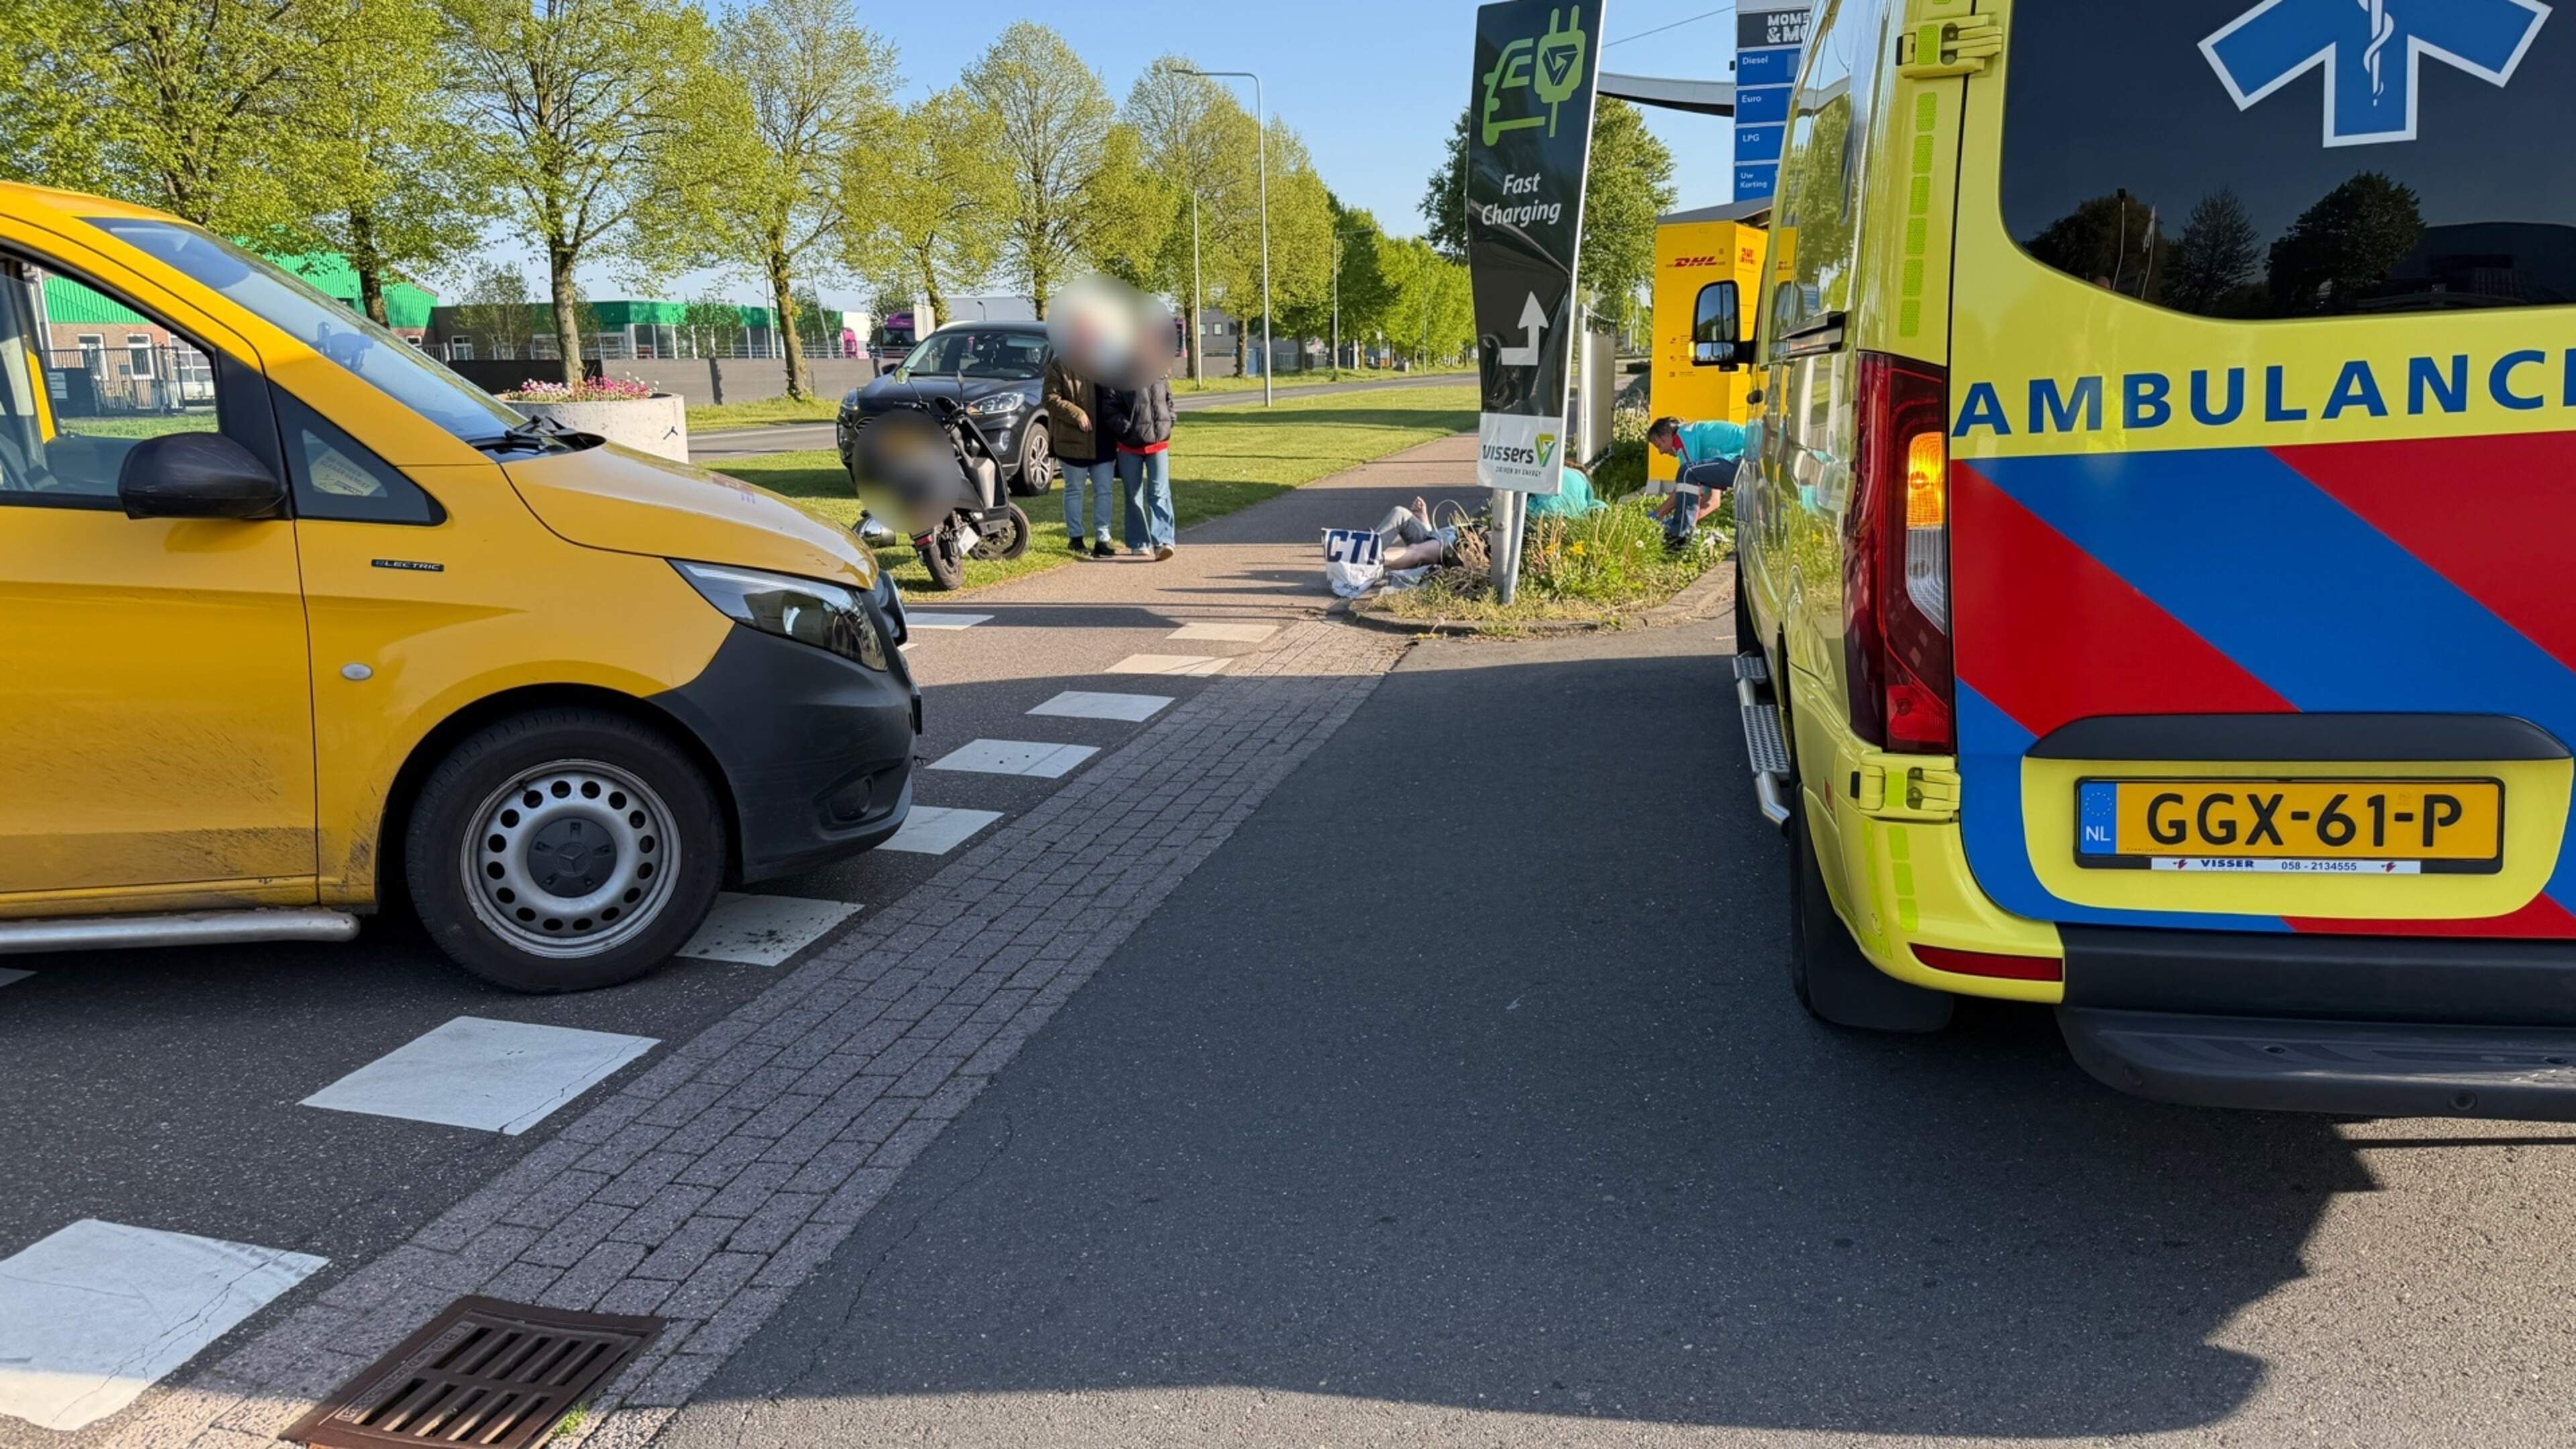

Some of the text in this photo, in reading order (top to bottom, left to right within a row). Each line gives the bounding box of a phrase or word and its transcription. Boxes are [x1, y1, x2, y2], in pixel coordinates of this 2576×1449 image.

[1766, 27, 1781, 43] &
[1742, 55, 1769, 65] Diesel
[1741, 95, 1762, 103] Euro
[1742, 133, 1760, 142] LPG
[1503, 172, 1542, 195] Fast
[1481, 199, 1562, 227] Charging
[1674, 256, 1717, 268] DHL
[2147, 792, 2463, 848] GGX-61-P
[2085, 825, 2111, 842] NL
[2200, 859, 2255, 868] VISSER
[2282, 861, 2301, 870] 058
[2311, 862, 2357, 871] 2134555
